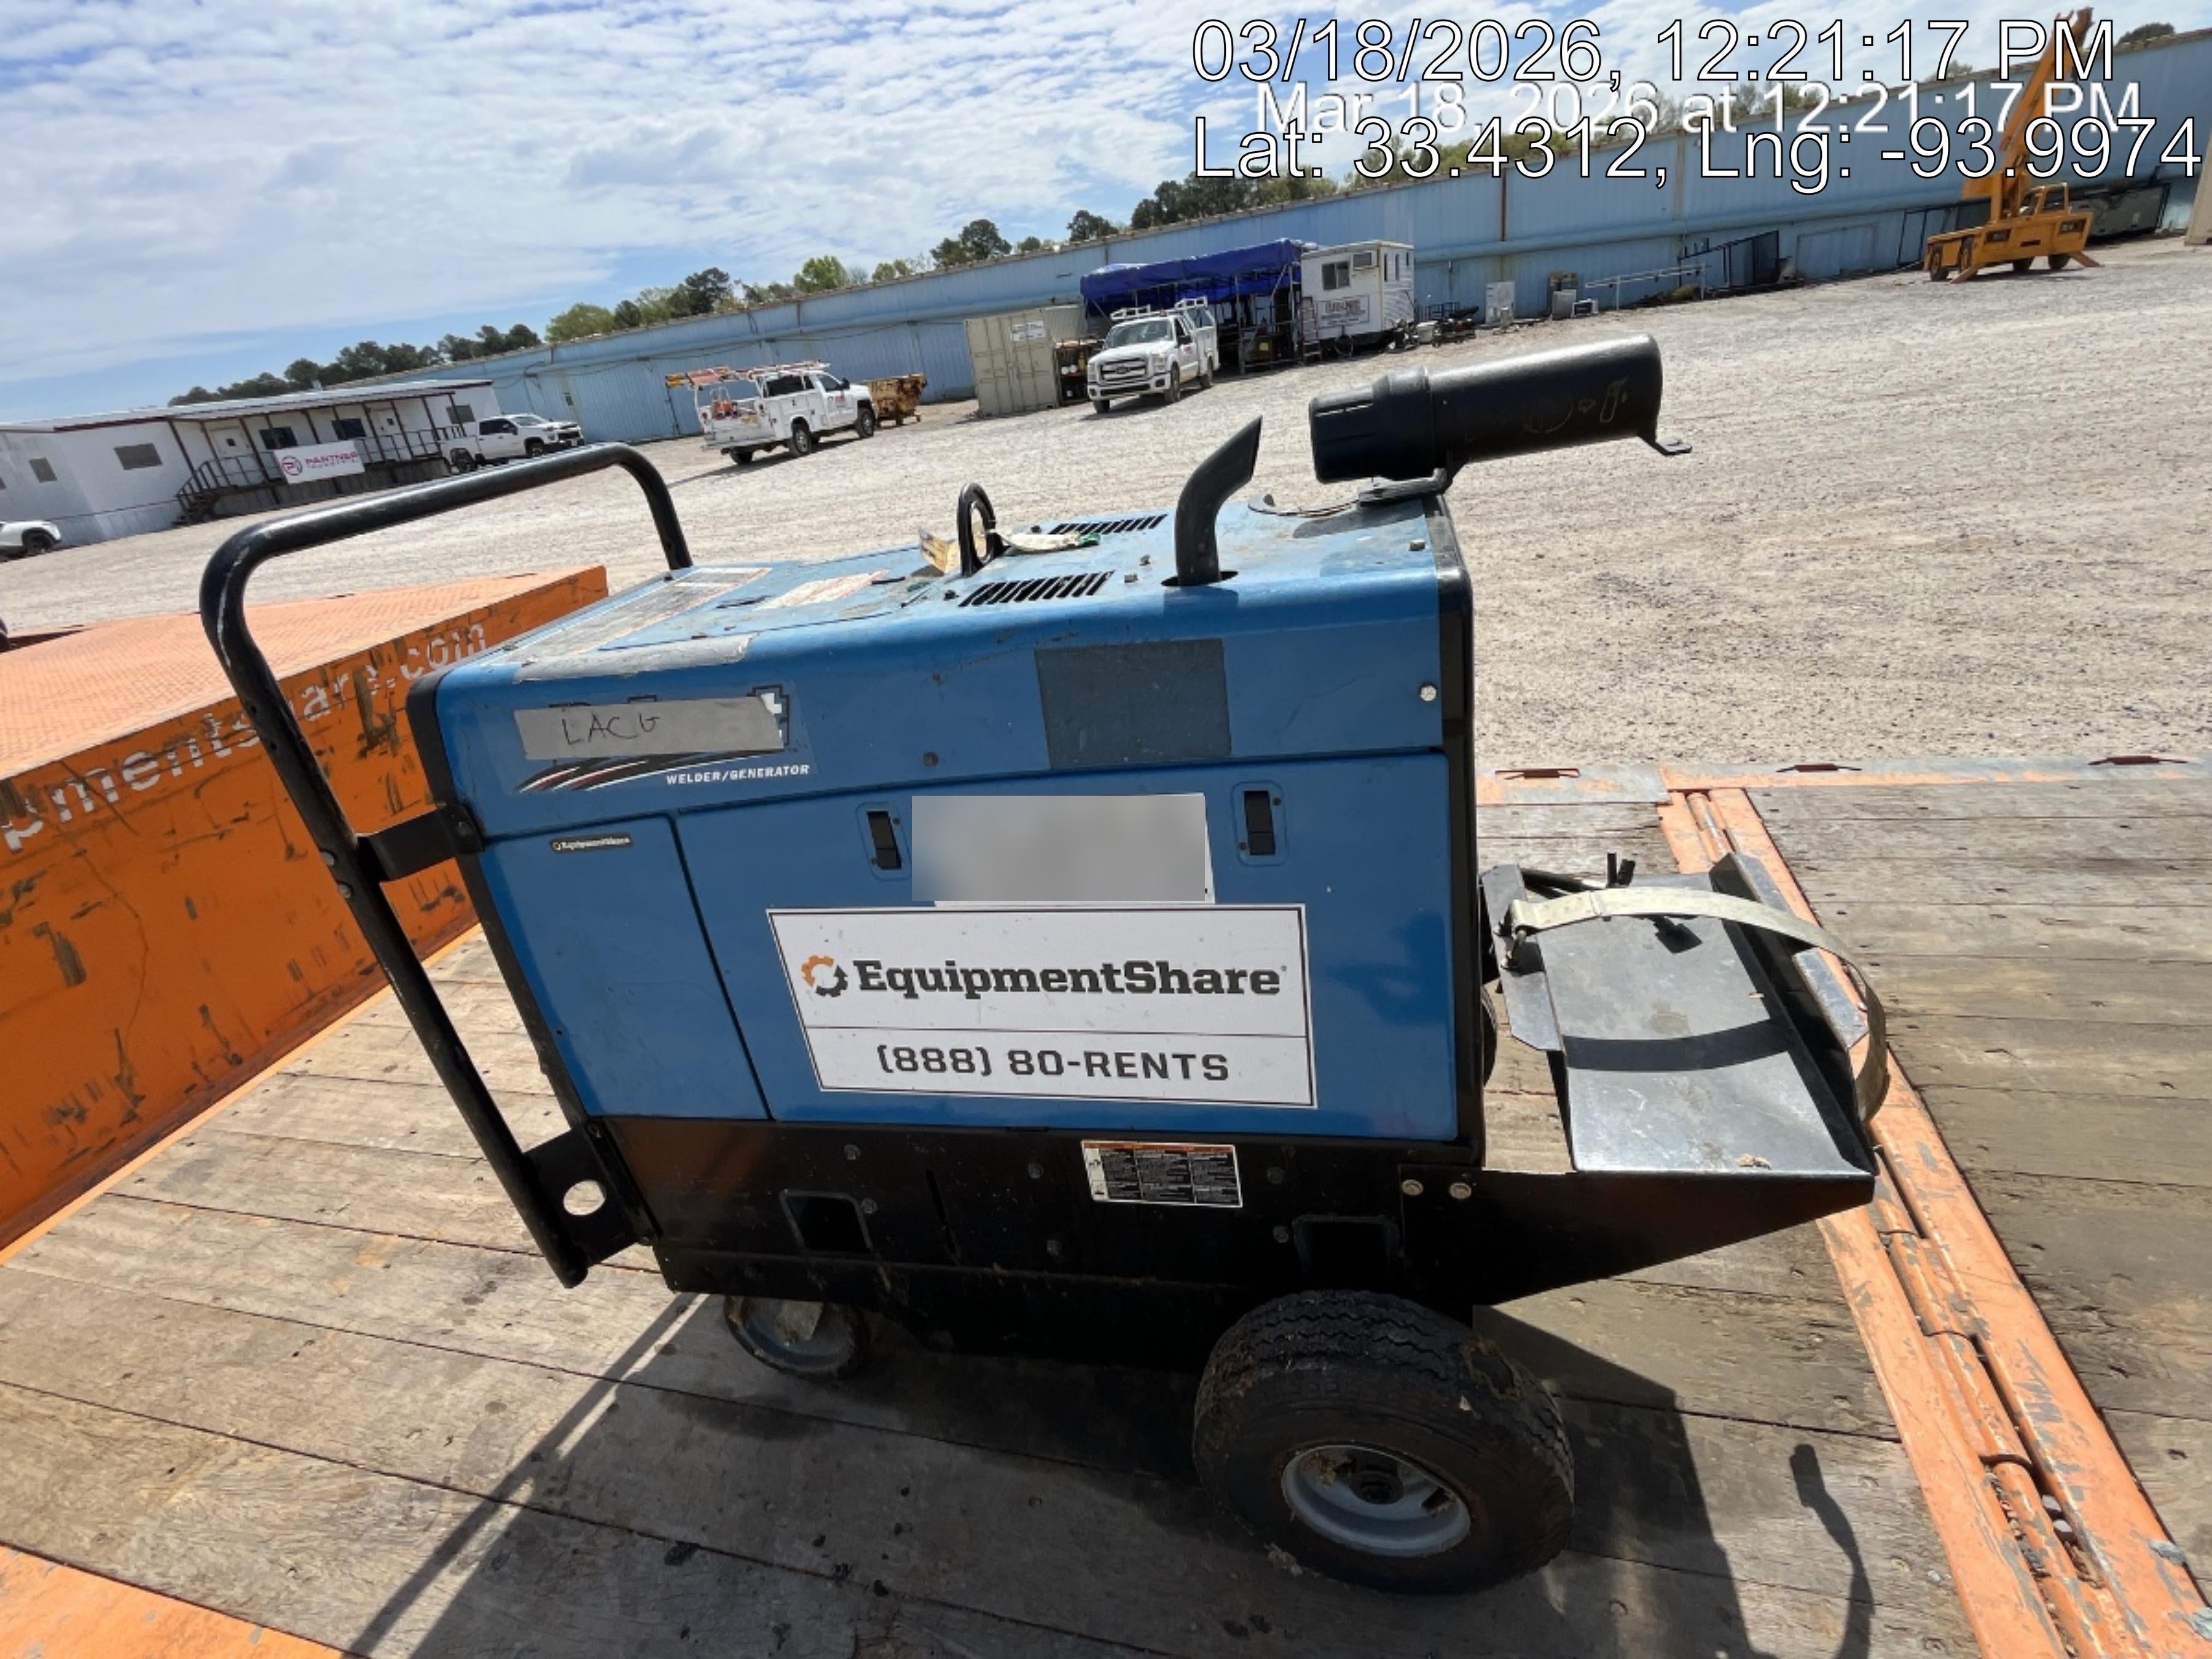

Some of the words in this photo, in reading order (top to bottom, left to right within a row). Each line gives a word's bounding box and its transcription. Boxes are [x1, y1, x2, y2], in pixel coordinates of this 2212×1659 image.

[666, 764, 810, 785] WELDER/GENERATOR
[852, 960, 1281, 1000] EquipmentShare
[877, 1045, 992, 1077] (888)
[1008, 1049, 1229, 1081] 80-RENTS
